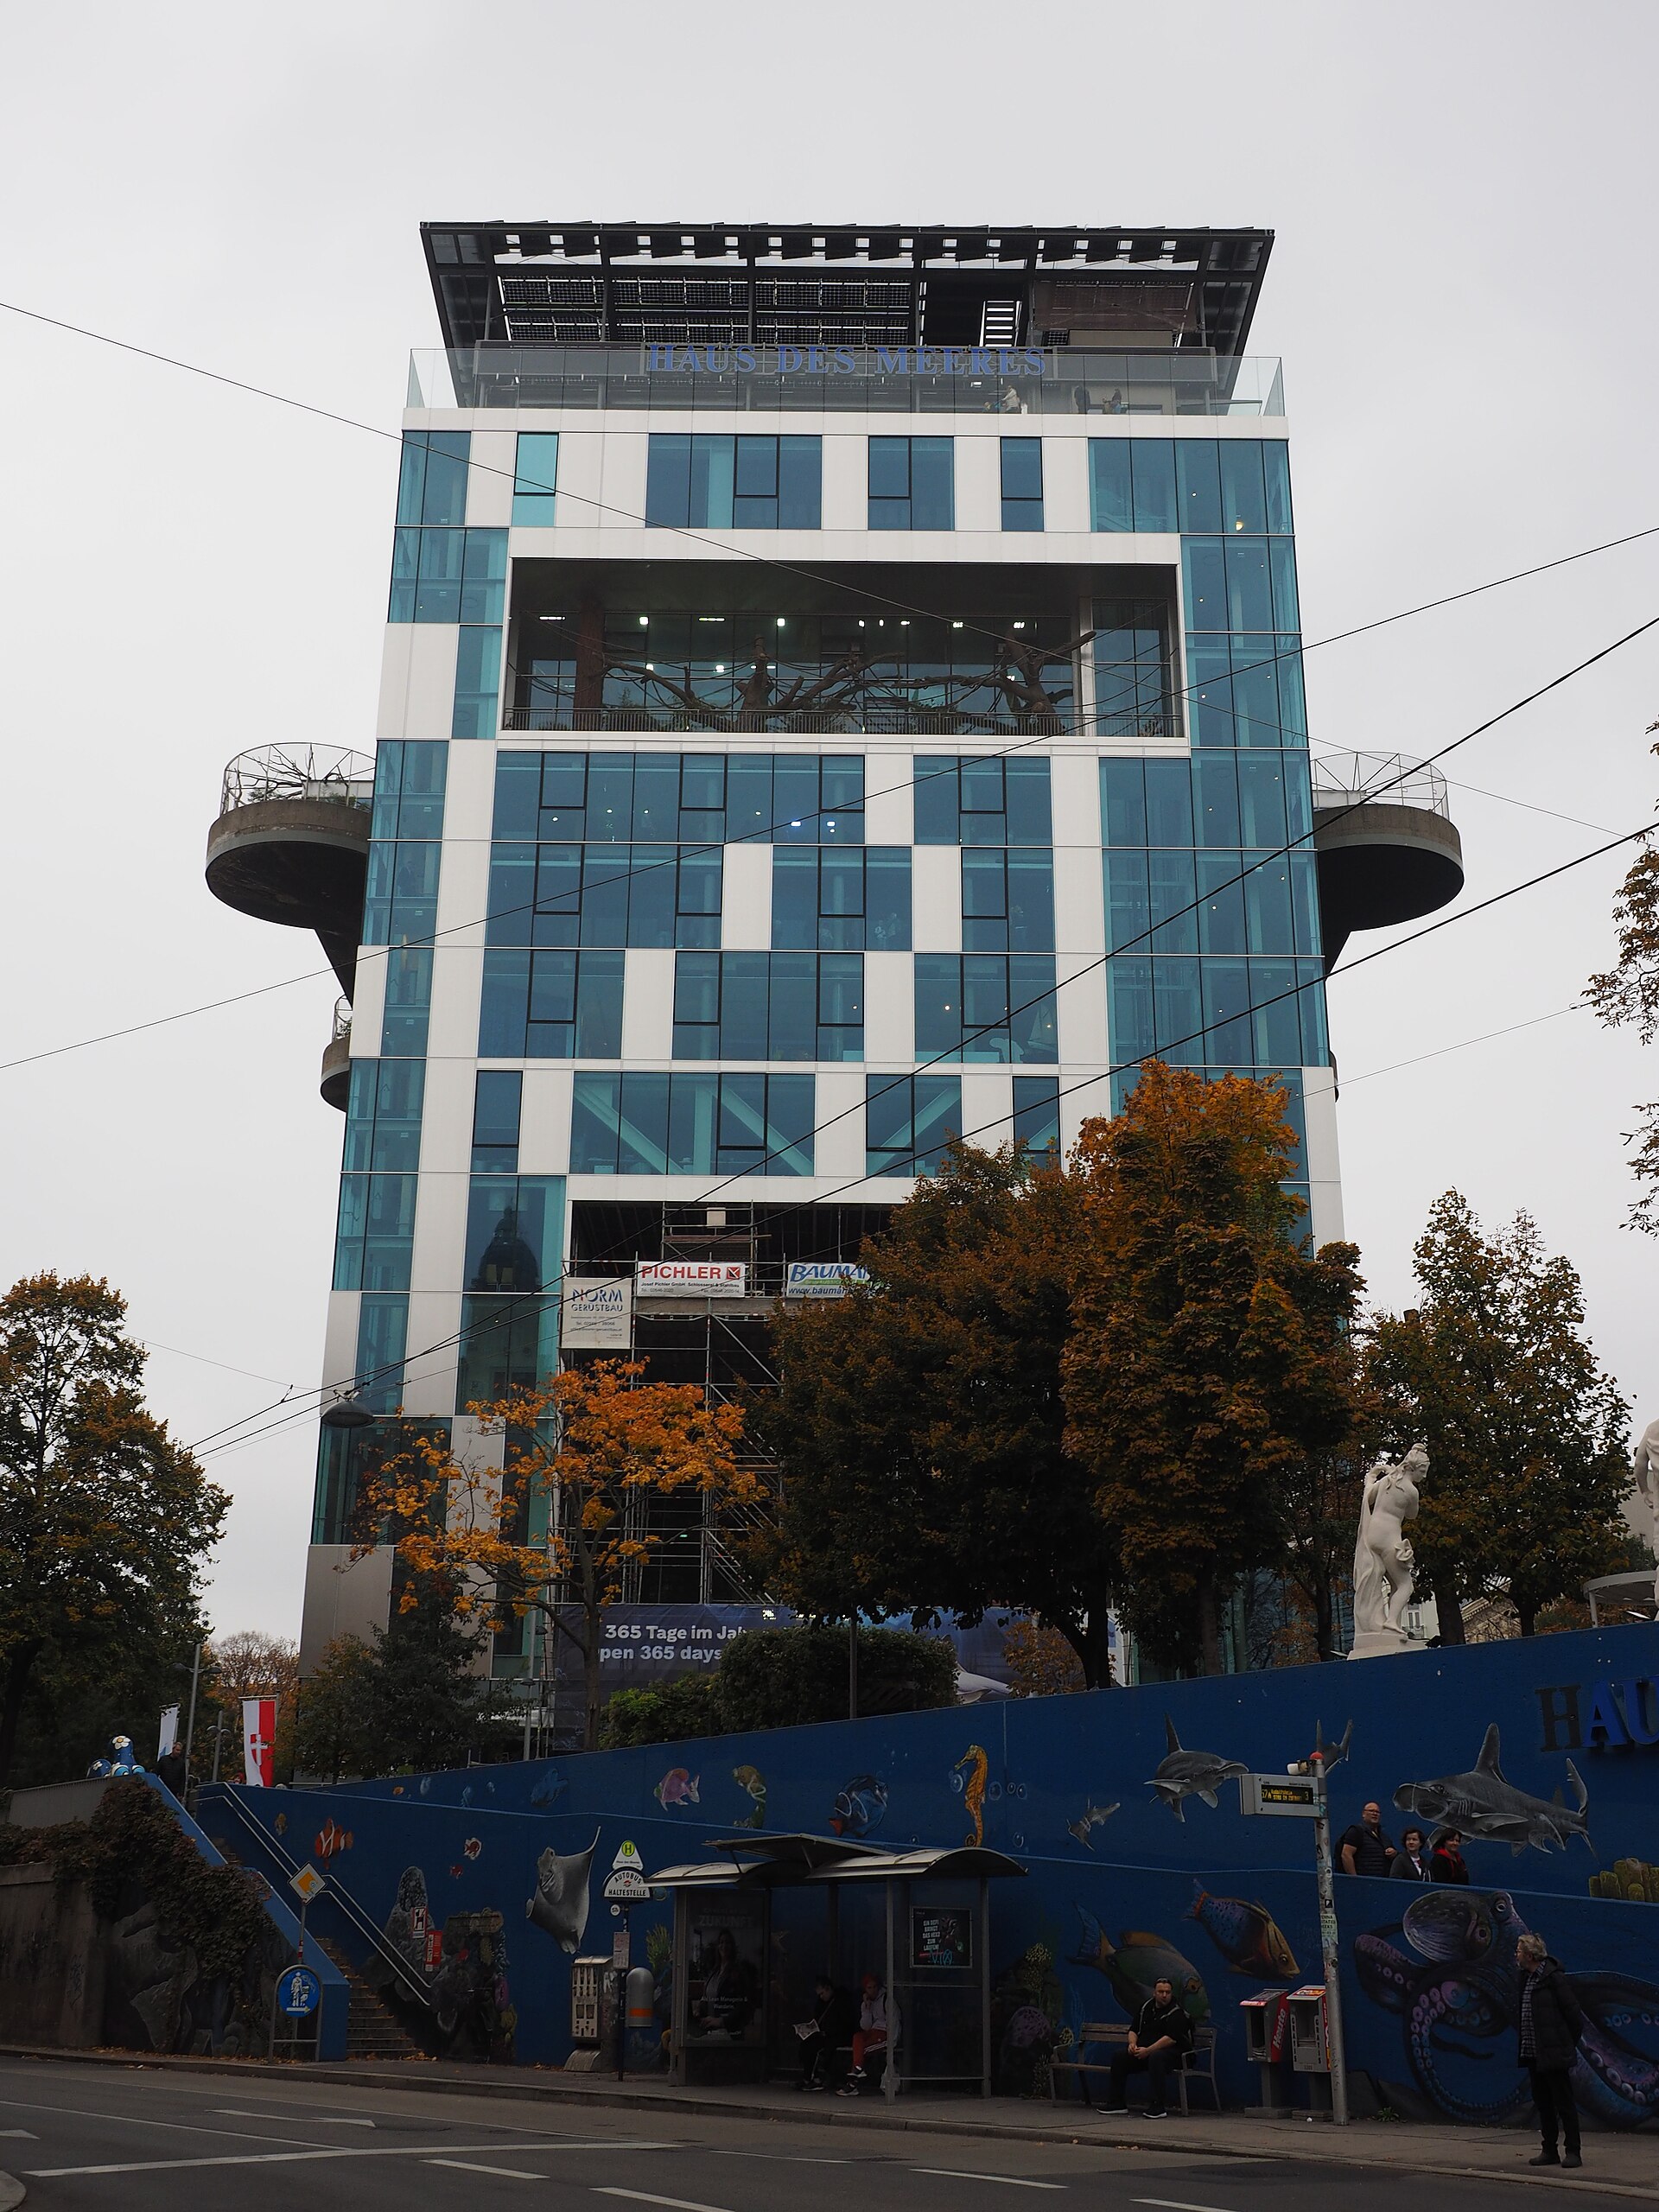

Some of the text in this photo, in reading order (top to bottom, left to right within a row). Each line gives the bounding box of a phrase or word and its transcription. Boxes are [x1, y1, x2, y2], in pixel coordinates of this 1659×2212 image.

[649, 344, 1046, 375] HAUS DES MEERES
[641, 1266, 721, 1279] PICHLER
[572, 1288, 623, 1302] NORM
[571, 1303, 623, 1312] GERÜSTBAU
[605, 1624, 642, 1639] 365
[645, 1625, 686, 1643] Tage
[691, 1625, 712, 1639] im
[598, 1646, 722, 1663] pen 365 days
[1305, 1791, 1309, 1801] 3
[625, 1844, 632, 1854] H
[614, 1872, 642, 1884] AUTOBUS
